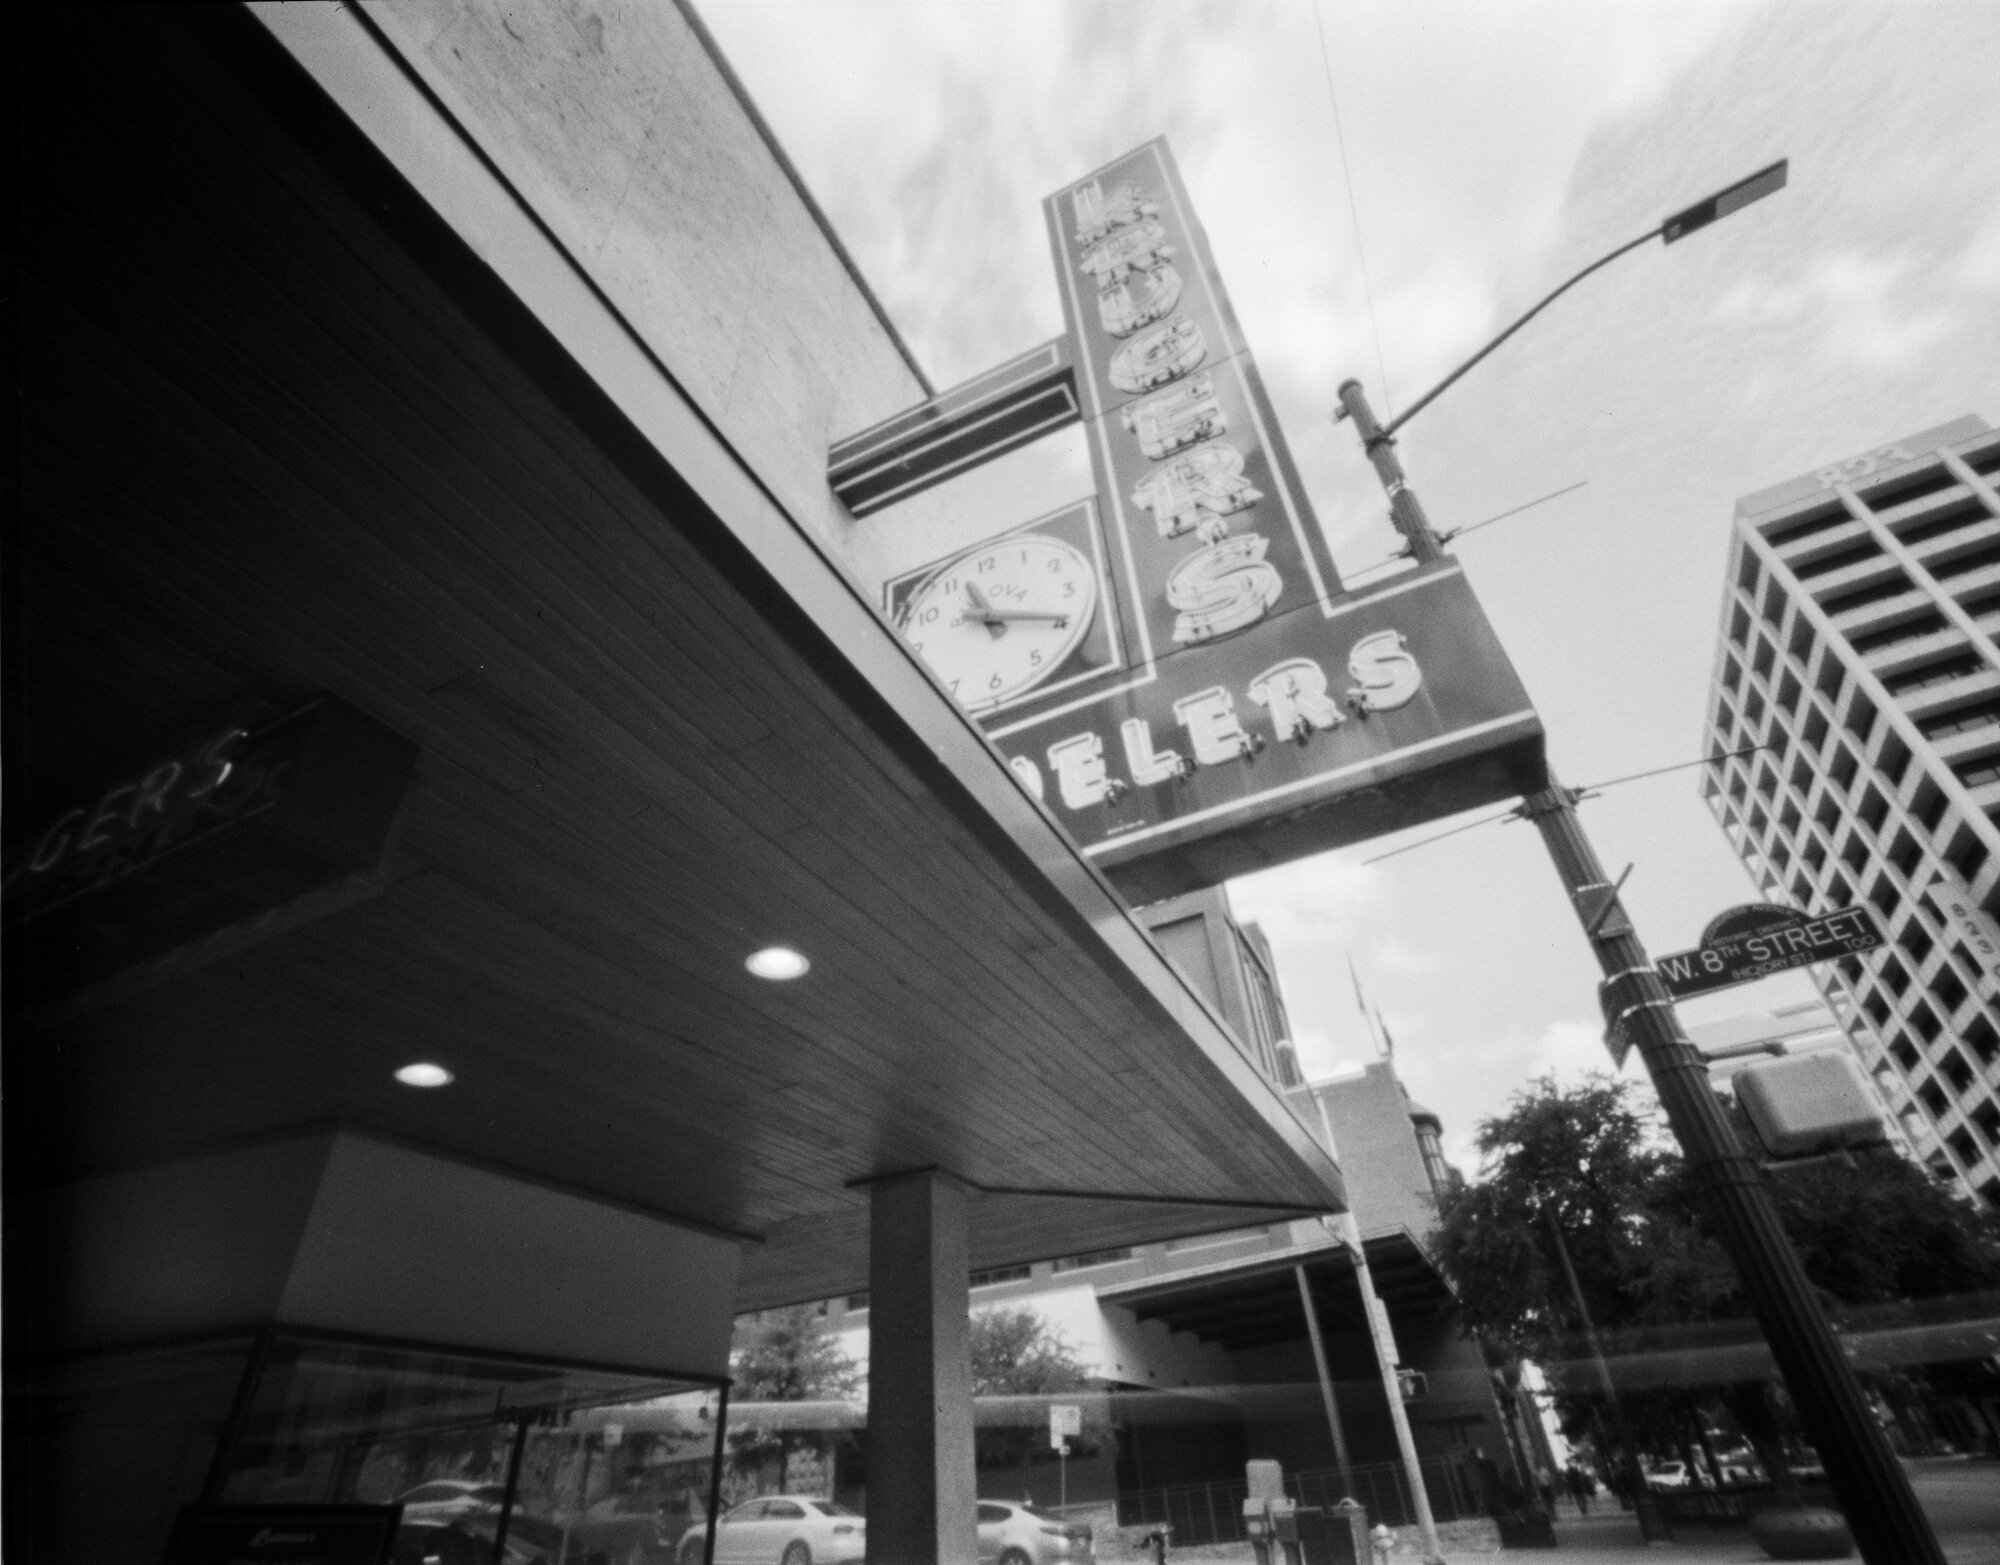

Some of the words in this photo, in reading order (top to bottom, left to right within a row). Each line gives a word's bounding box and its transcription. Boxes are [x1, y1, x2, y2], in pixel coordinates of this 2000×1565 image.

[977, 556, 996, 573] 12
[1020, 550, 1028, 564] 1
[1047, 558, 1063, 573] 2
[944, 578, 958, 596] 11
[1063, 581, 1076, 598] 3
[919, 607, 940, 627] 10
[1030, 649, 1043, 667] 5
[949, 678, 962, 696] 7
[989, 671, 1003, 690] 6
[1660, 956, 1700, 984] W.
[1700, 943, 1742, 973] 8TH
[1746, 909, 1869, 961] STREET
[1843, 933, 1879, 950] 100
